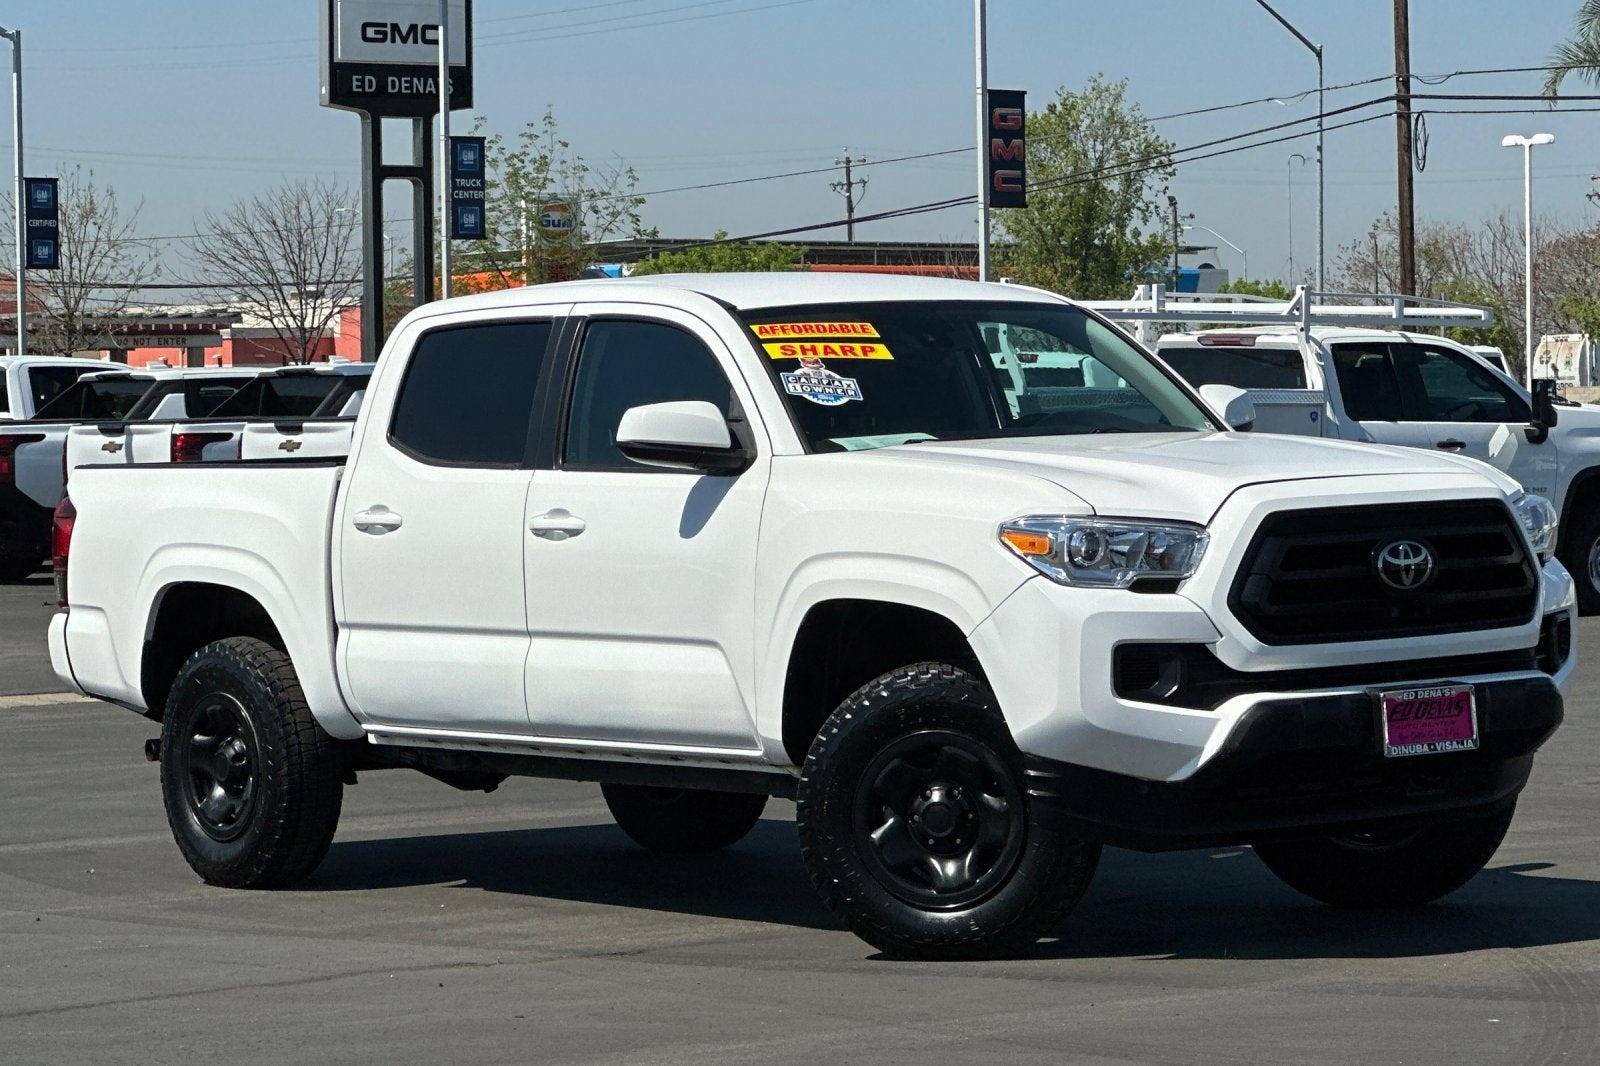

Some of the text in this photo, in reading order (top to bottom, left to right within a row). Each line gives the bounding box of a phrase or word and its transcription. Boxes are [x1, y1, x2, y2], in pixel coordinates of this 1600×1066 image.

[361, 22, 439, 45] GMC
[352, 76, 454, 94] ED DENA
[992, 108, 1024, 191] GMC
[463, 150, 474, 161] GM
[456, 179, 482, 187] TRUCK
[36, 190, 48, 200] GM
[453, 190, 484, 199] CENTER
[28, 219, 57, 228] CERTIFIED
[463, 213, 475, 224] GM
[37, 245, 49, 256] GM
[758, 323, 872, 335] AFFORDABLE
[133, 337, 150, 346] NOT
[157, 337, 187, 346] ENTER
[779, 344, 876, 357] SHARP
[787, 376, 855, 389] CARFAX
[802, 385, 855, 396] OWNER
[1403, 688, 1452, 700] ED DENA'S
[1391, 739, 1474, 755] DINUBA VISALIA
